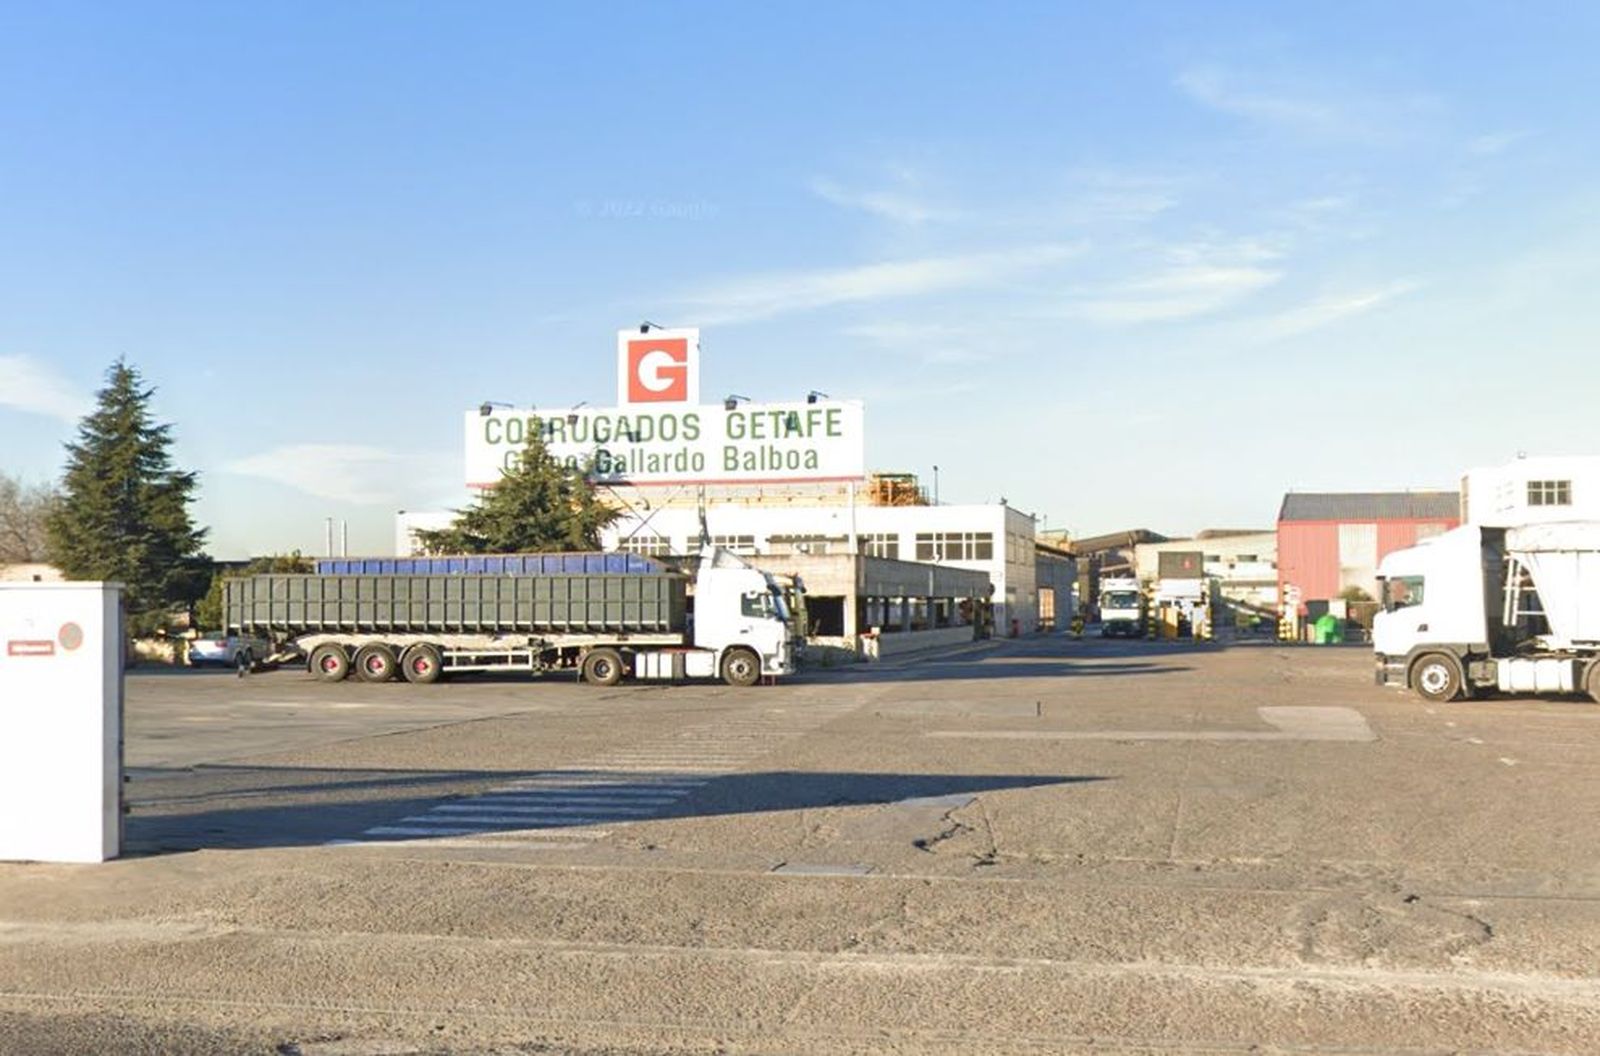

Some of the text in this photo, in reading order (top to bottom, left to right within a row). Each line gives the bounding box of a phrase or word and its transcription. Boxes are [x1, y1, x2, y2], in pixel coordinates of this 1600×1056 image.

[637, 350, 688, 392] G
[485, 408, 843, 445] CORUGADOS GETAFE
[595, 446, 705, 474] Gallardo
[724, 445, 819, 472] Balboa
